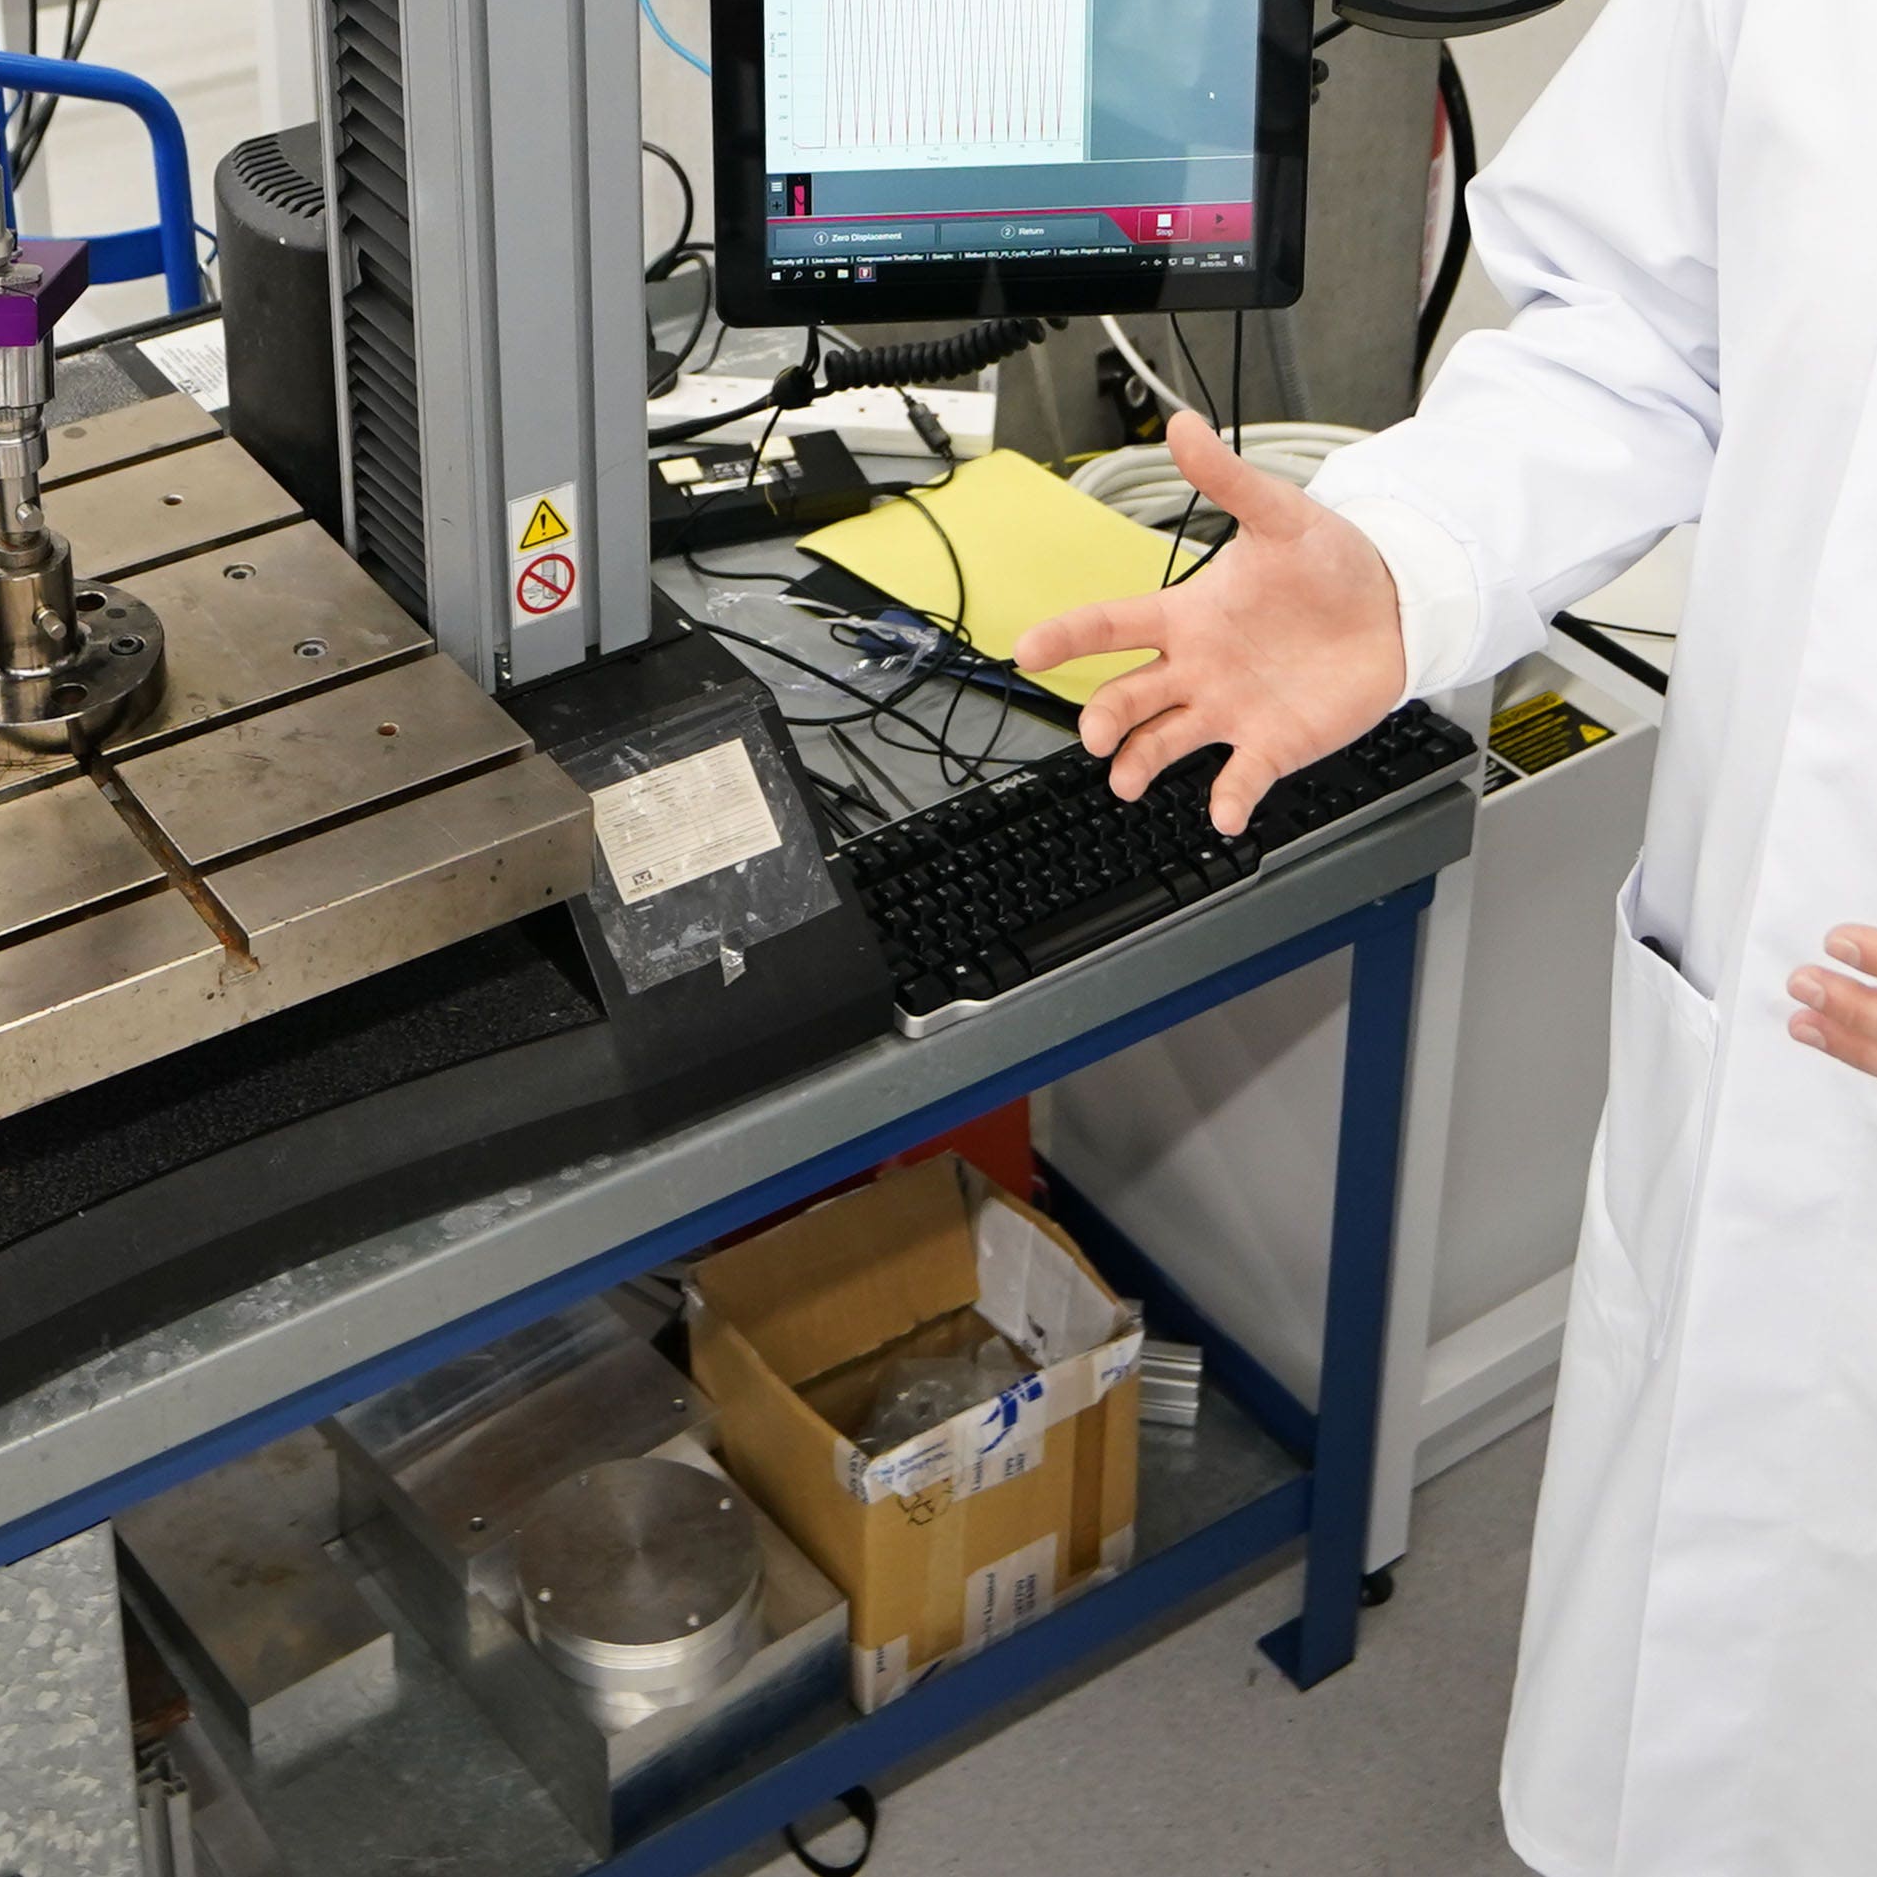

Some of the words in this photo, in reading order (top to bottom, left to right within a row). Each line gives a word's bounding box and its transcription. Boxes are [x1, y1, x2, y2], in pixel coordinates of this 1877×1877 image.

[831, 233, 850, 243] Zero
[851, 231, 903, 243] Displacement
[1018, 227, 1045, 237] Return
[1155, 227, 1174, 237] Stop
[824, 256, 848, 264] machine
[856, 255, 892, 264] Compression
[986, 770, 1039, 795] DELL
